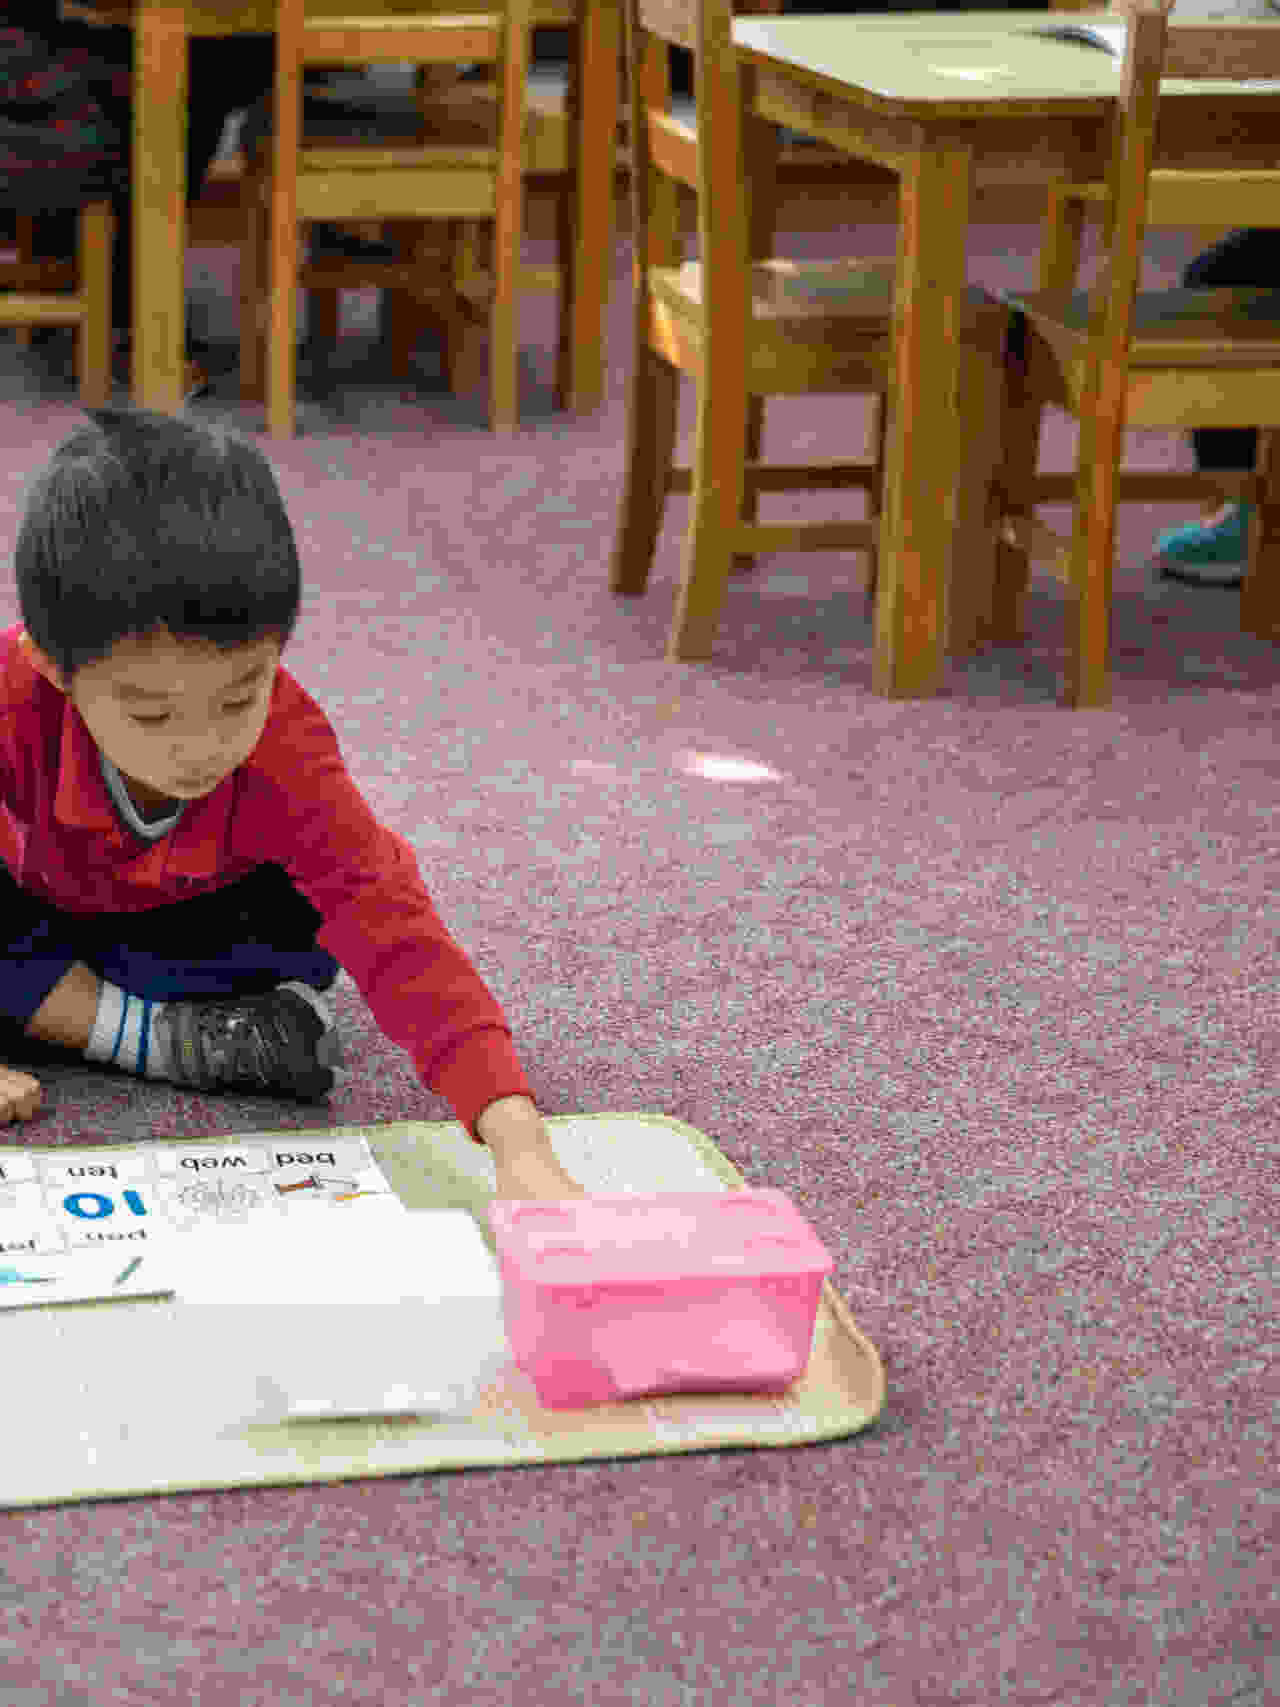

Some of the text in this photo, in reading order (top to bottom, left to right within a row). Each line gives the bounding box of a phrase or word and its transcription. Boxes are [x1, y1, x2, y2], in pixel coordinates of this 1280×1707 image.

[179, 1155, 248, 1172] web
[276, 1151, 336, 1168] bed
[65, 1163, 119, 1180] ten
[62, 1188, 148, 1220] 10
